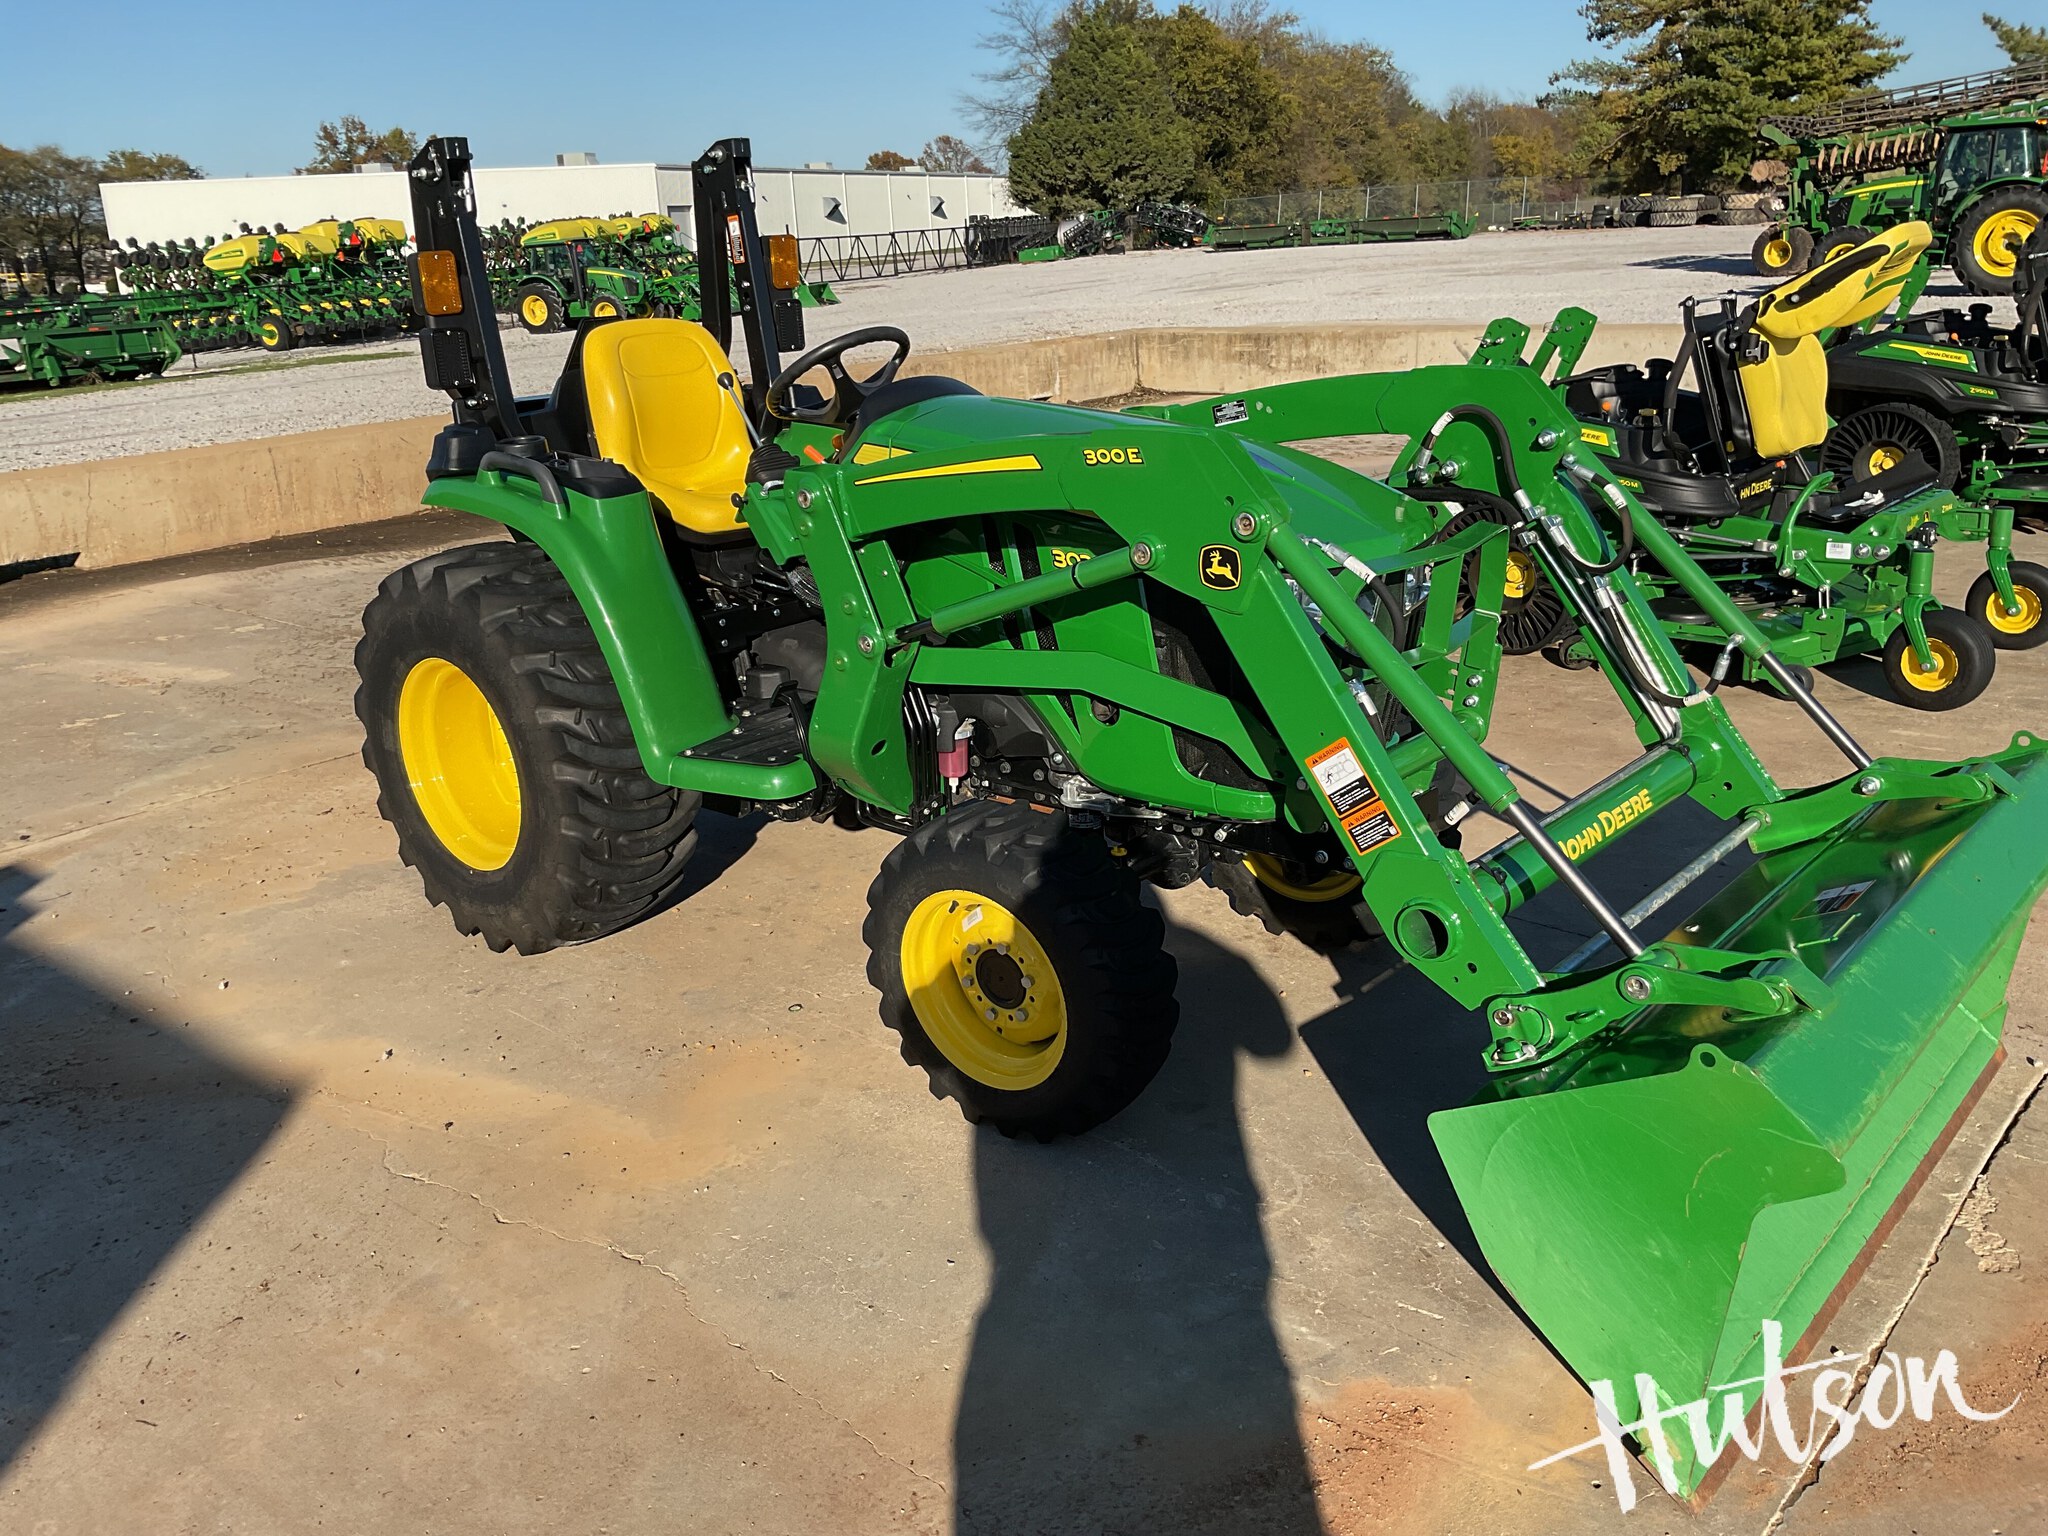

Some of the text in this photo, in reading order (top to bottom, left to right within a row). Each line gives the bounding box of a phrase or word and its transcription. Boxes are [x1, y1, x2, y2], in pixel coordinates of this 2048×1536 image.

[1942, 352, 1962, 360] DEERE
[1581, 432, 1601, 440] EERE
[1740, 478, 1773, 500] HN DEERE
[1317, 742, 1344, 761] WARNING
[1354, 805, 1381, 823] WARNING
[1557, 788, 1653, 860] JOHN DEERE
